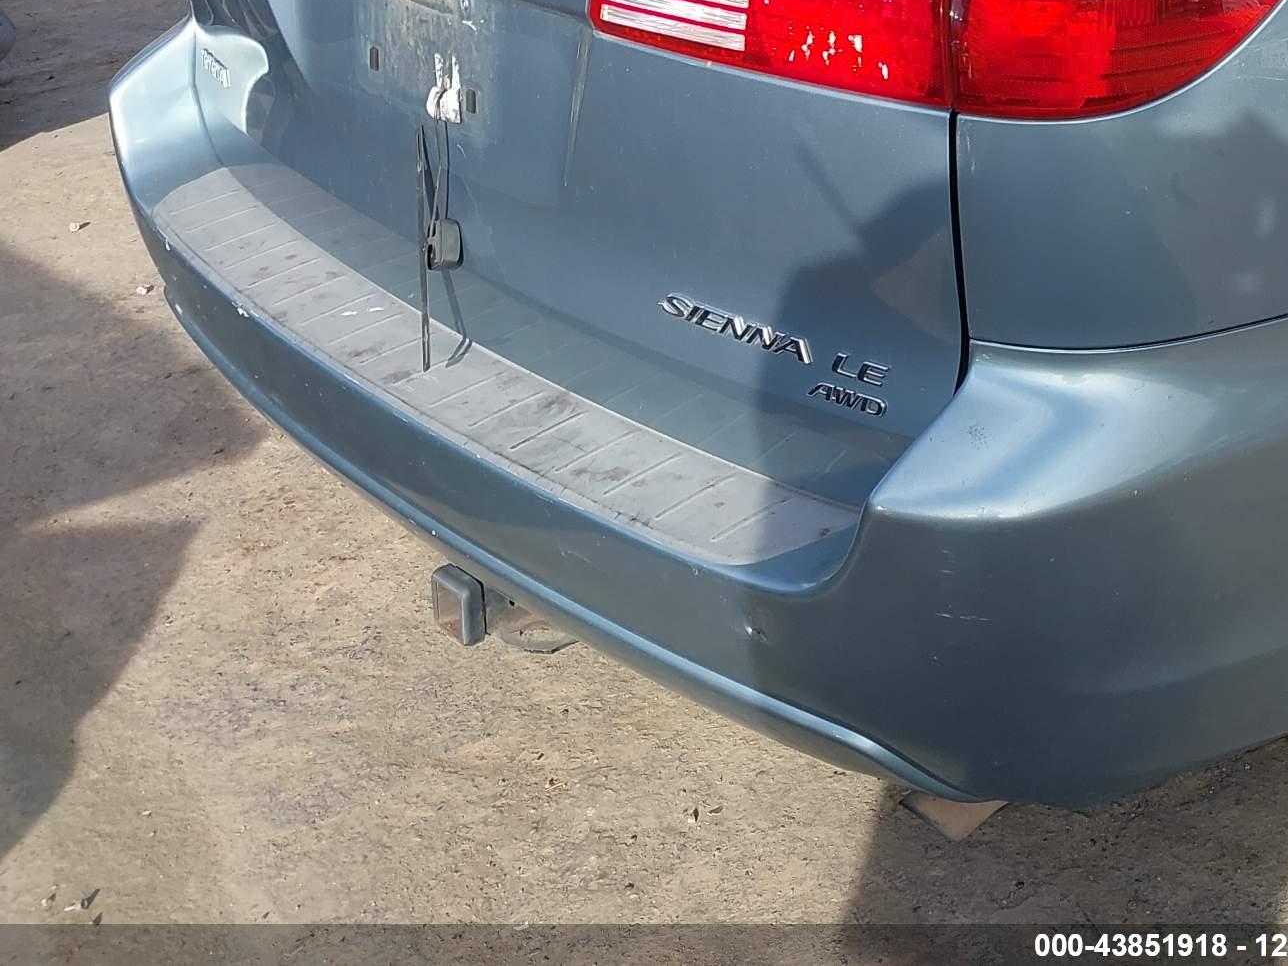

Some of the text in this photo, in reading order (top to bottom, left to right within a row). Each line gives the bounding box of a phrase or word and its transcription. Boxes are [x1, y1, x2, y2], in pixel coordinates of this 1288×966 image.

[658, 292, 891, 386] SIENNA LE
[807, 382, 888, 418] AWD
